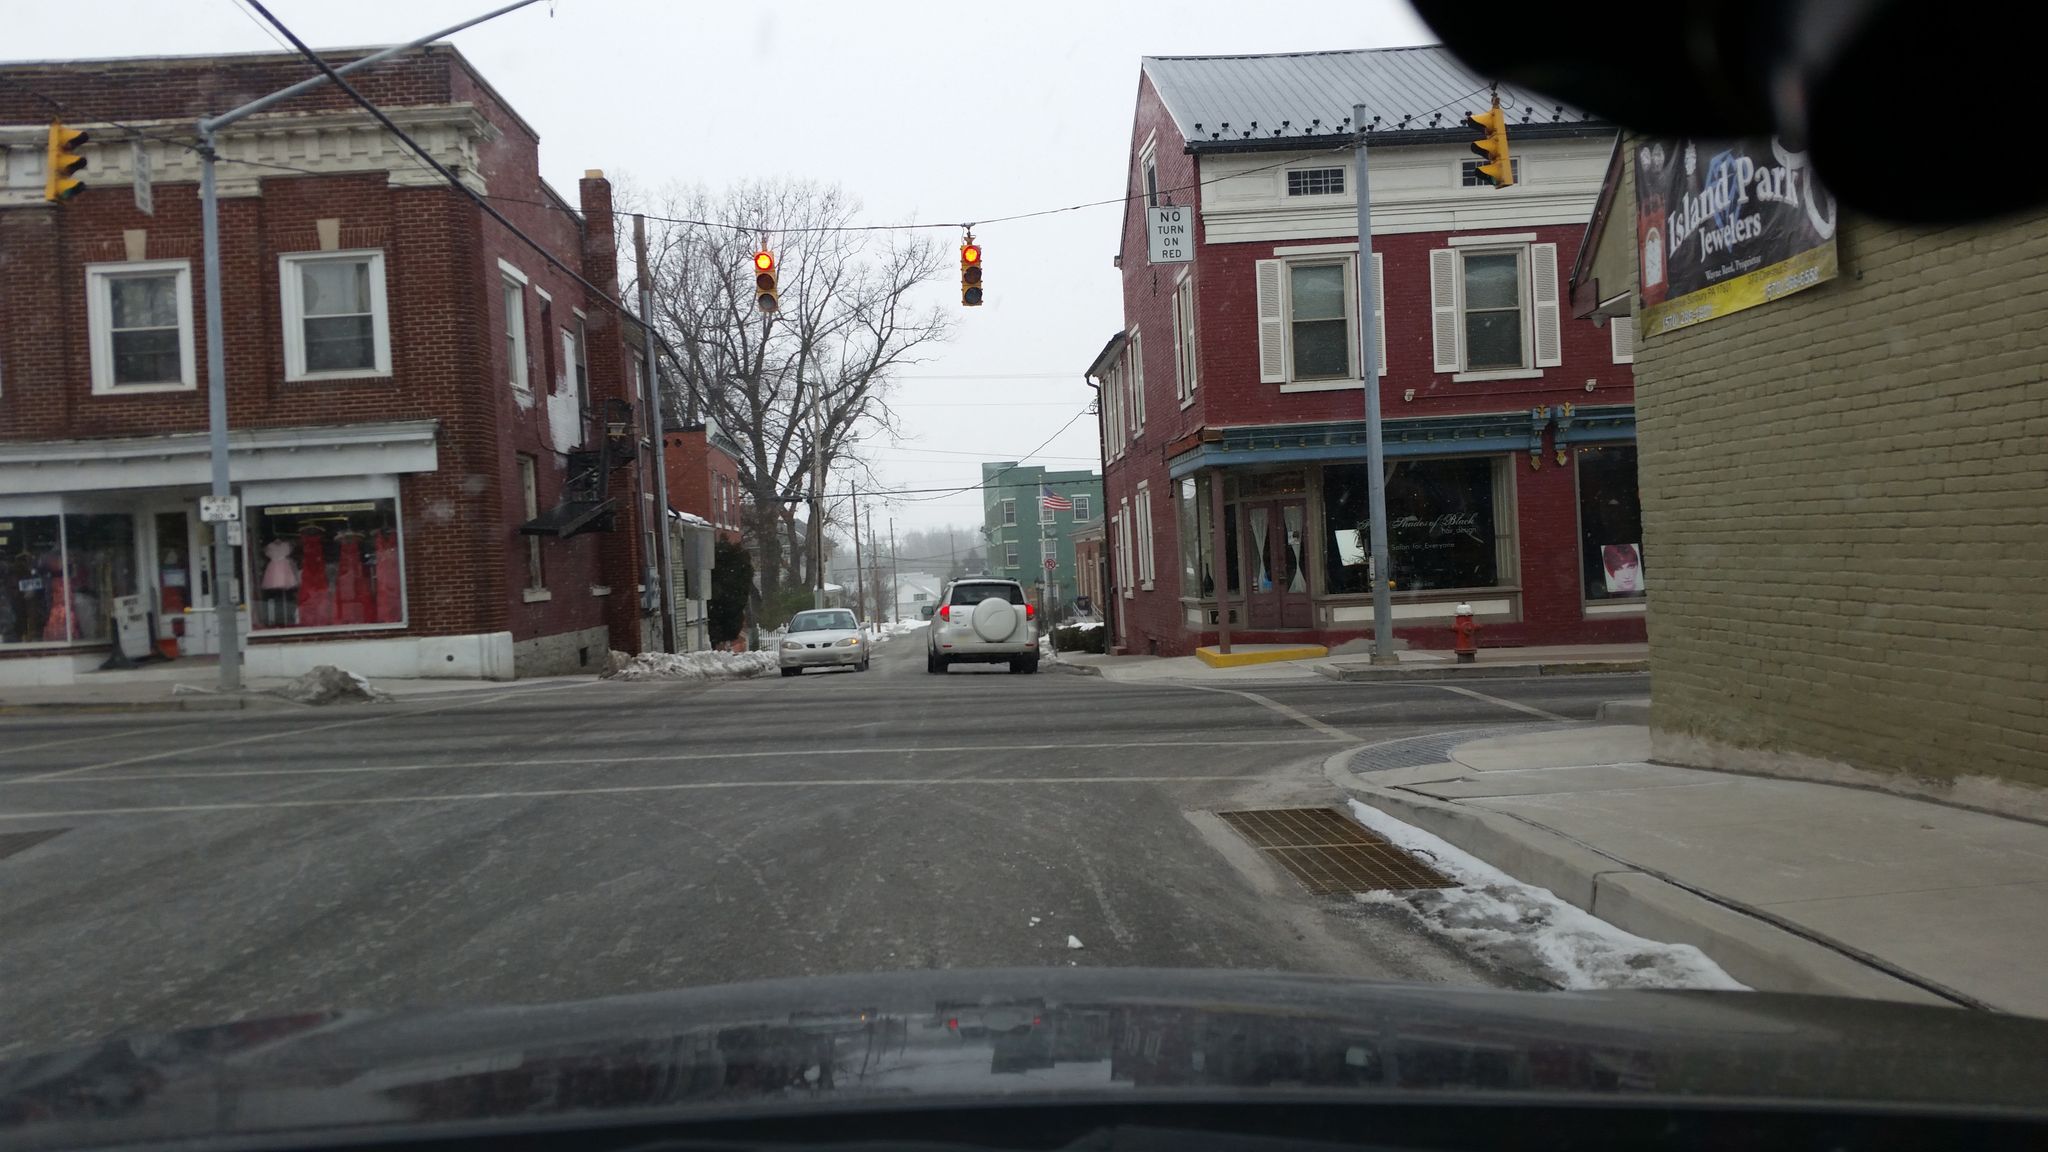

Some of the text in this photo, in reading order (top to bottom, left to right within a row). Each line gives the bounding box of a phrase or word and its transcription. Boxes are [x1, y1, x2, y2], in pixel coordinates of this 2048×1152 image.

[1667, 155, 1798, 258] Island Park
[1161, 212, 1180, 222] NO
[1158, 226, 1183, 234] TURN
[1699, 211, 1762, 263] Jewelers
[1164, 238, 1178, 246] ON
[1163, 250, 1181, 258] RED
[1391, 512, 1479, 533] Shades of Black
[1424, 542, 1456, 551] Everyone
